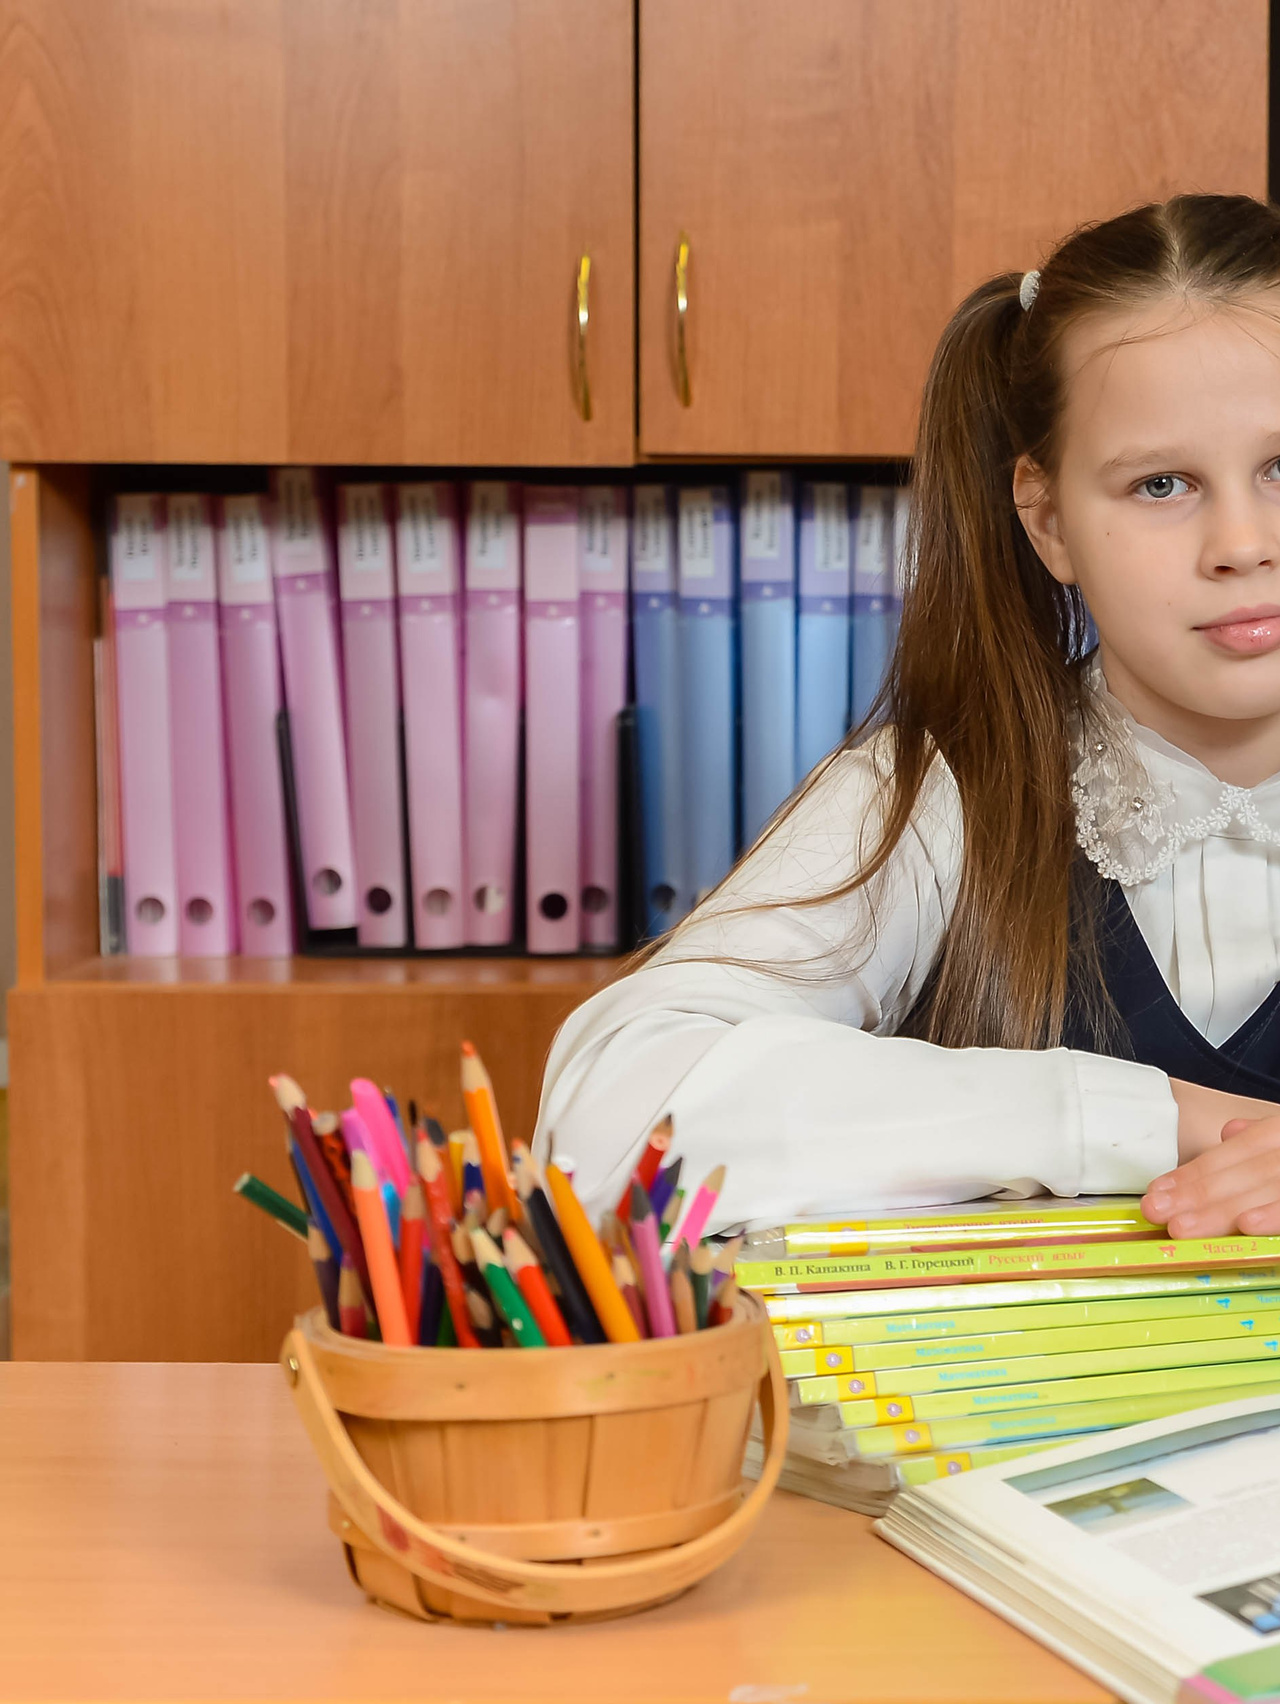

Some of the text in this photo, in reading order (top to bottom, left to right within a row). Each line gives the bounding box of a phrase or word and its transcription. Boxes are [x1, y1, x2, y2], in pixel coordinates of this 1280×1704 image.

[774, 1266, 786, 1277] В.
[789, 1265, 803, 1276] П.
[806, 1264, 872, 1276] Канакина
[885, 1261, 897, 1271] В.
[900, 1260, 909, 1270] Г.
[912, 1256, 974, 1271] Горецкий
[988, 1253, 1044, 1266] Русский
[1052, 1251, 1085, 1262] язык
[1203, 1243, 1243, 1254] Часть
[1250, 1241, 1258, 1252] 2
